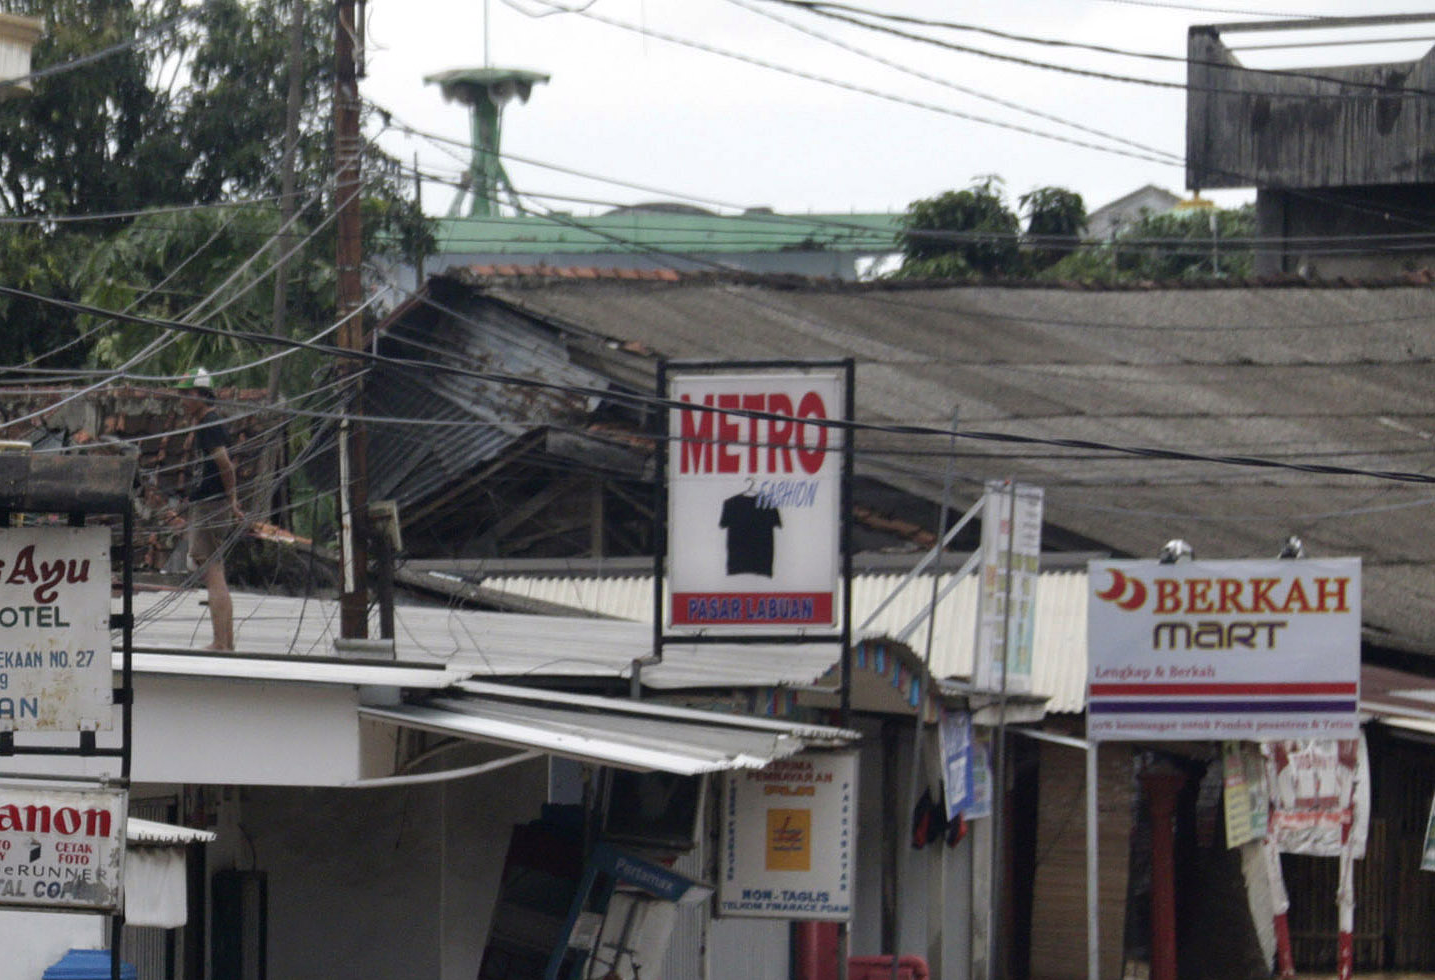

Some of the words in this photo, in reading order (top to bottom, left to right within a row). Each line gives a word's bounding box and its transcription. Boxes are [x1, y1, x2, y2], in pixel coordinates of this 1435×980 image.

[680, 391, 827, 475] METRO
[755, 481, 819, 509] FASHION
[5, 545, 91, 604] Ayu
[1152, 576, 1350, 614] BERKAH
[687, 599, 741, 620] PASAR
[746, 599, 814, 620] LABUAN
[50, 651, 71, 668] NO.
[76, 651, 95, 667] 27
[55, 842, 92, 854] CETAK
[58, 852, 89, 866] FOTO
